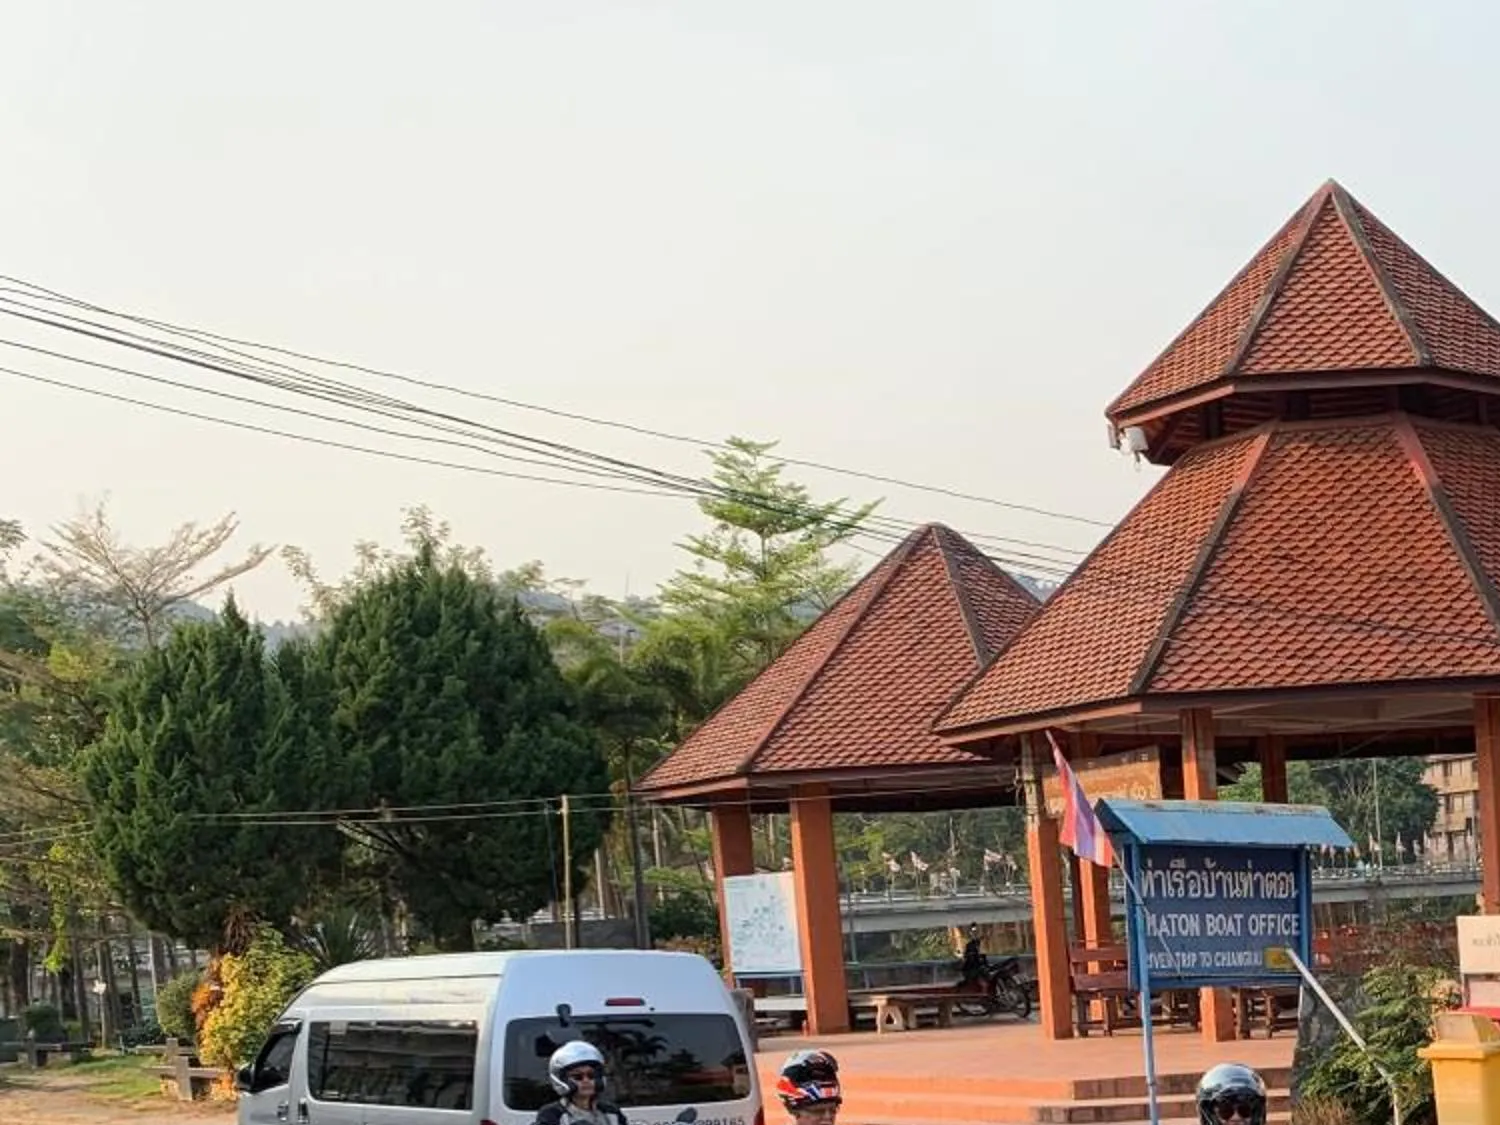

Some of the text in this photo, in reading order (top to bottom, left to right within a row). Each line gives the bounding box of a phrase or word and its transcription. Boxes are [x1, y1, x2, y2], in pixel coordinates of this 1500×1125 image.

[1205, 912, 1244, 937] BOAT
[1248, 912, 1300, 936] OFFICE
[1199, 952, 1213, 967] TO
